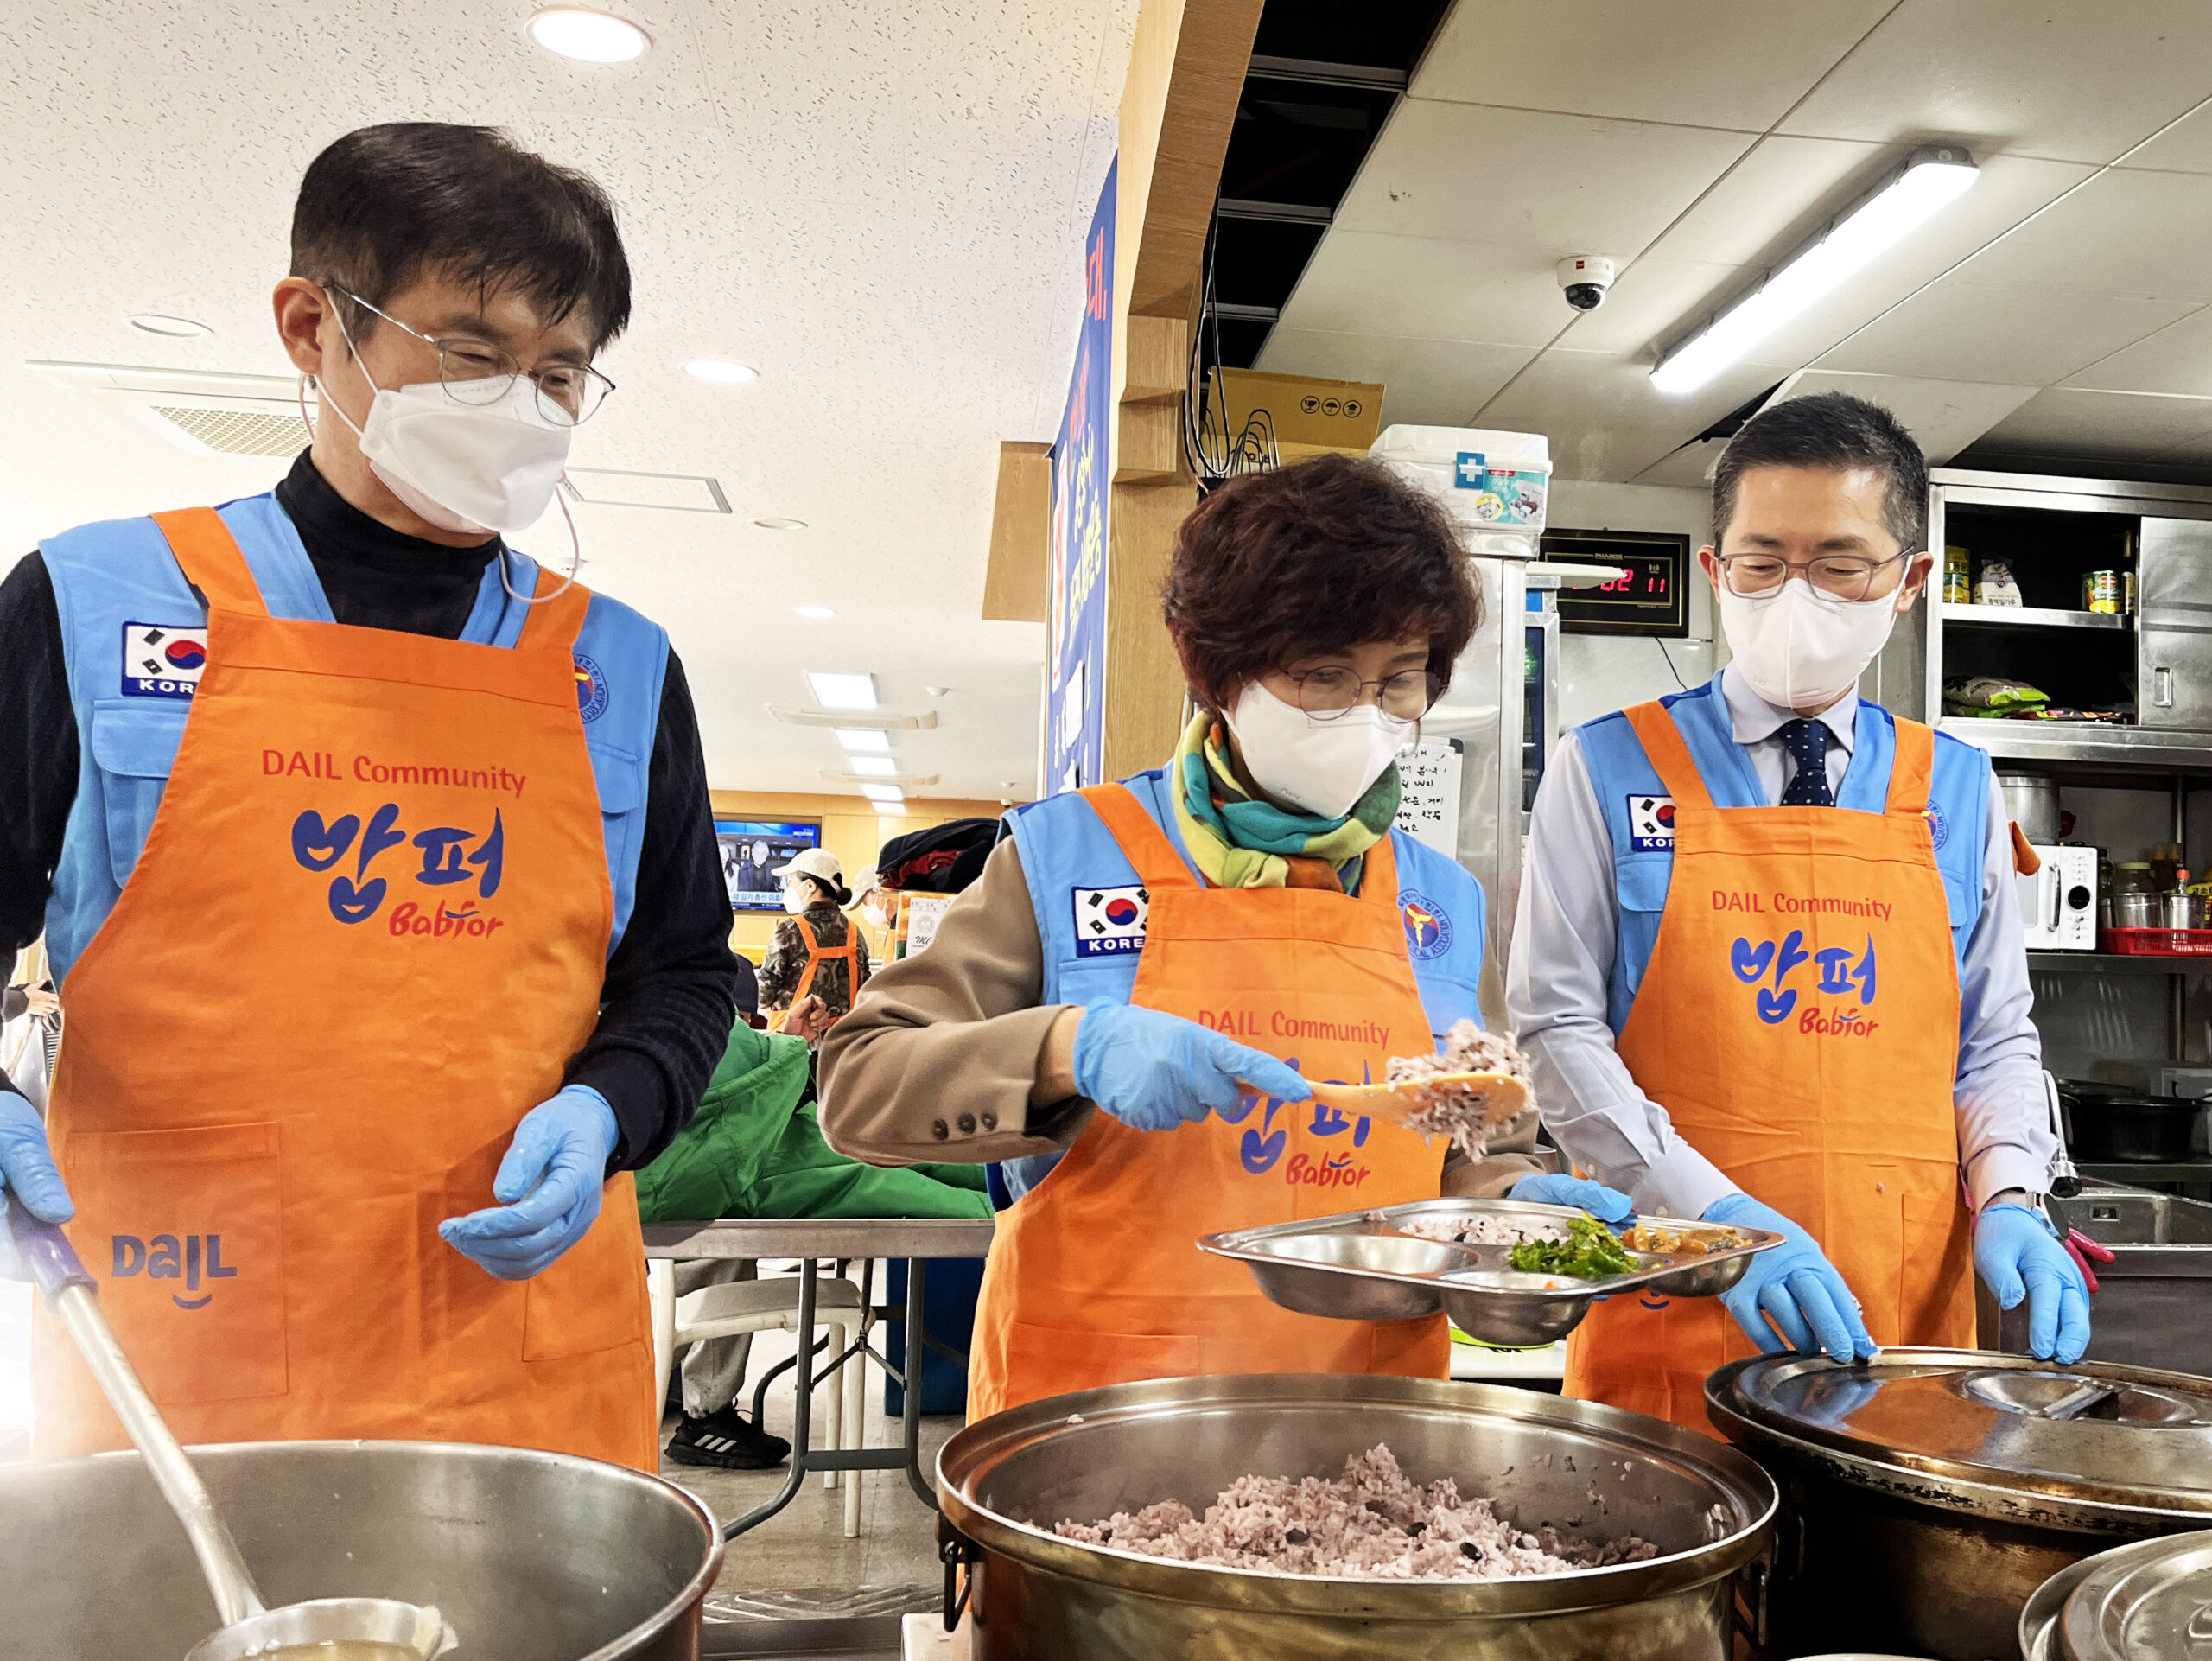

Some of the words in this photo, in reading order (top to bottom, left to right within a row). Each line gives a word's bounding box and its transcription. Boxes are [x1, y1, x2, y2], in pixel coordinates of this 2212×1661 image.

[1648, 577, 1666, 593] 11
[262, 749, 343, 781] DAIL
[353, 754, 527, 799] Community
[291, 804, 505, 924] 밥퍼
[1712, 890, 1766, 913] DAIL
[1773, 892, 1893, 923] Community
[1730, 929, 1877, 1025] 밥퍼
[1198, 1009, 1262, 1038] DAIL
[1271, 1010, 1390, 1052] Community
